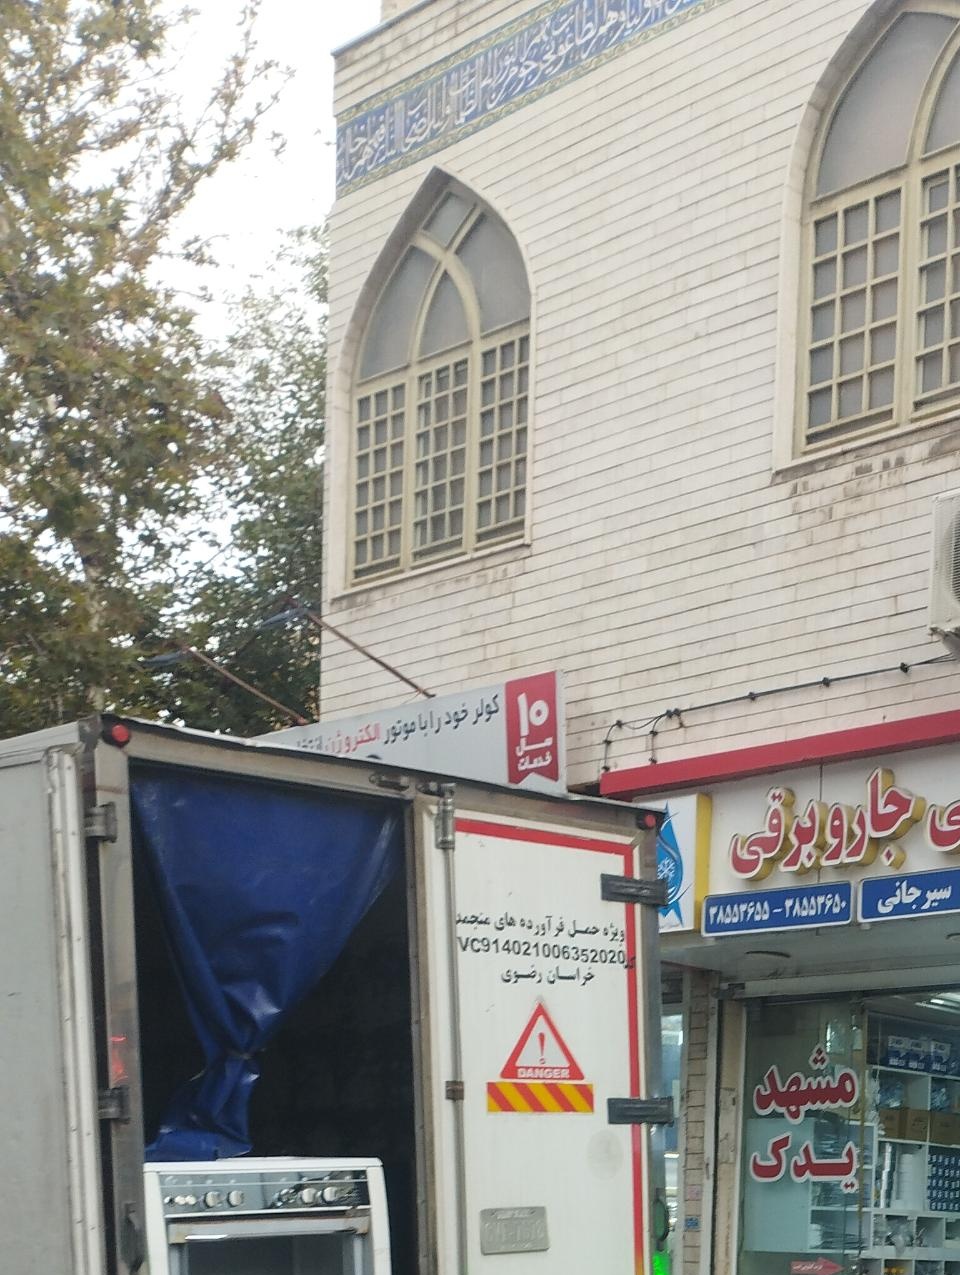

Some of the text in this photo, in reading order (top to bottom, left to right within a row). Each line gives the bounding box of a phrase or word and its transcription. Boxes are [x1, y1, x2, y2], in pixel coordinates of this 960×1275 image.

[445, 703, 468, 730] خود
[877, 879, 952, 914] سیرجانی
[494, 912, 516, 931] های
[568, 919, 600, 938] حمل
[602, 921, 625, 947] ویژه
[457, 936, 625, 965] VC914021006352020
[501, 964, 595, 986] خراسان رضوی
[517, 1067, 570, 1079] DANGER
[755, 1045, 858, 1122] مشهد
[752, 1131, 859, 1192] یدک
